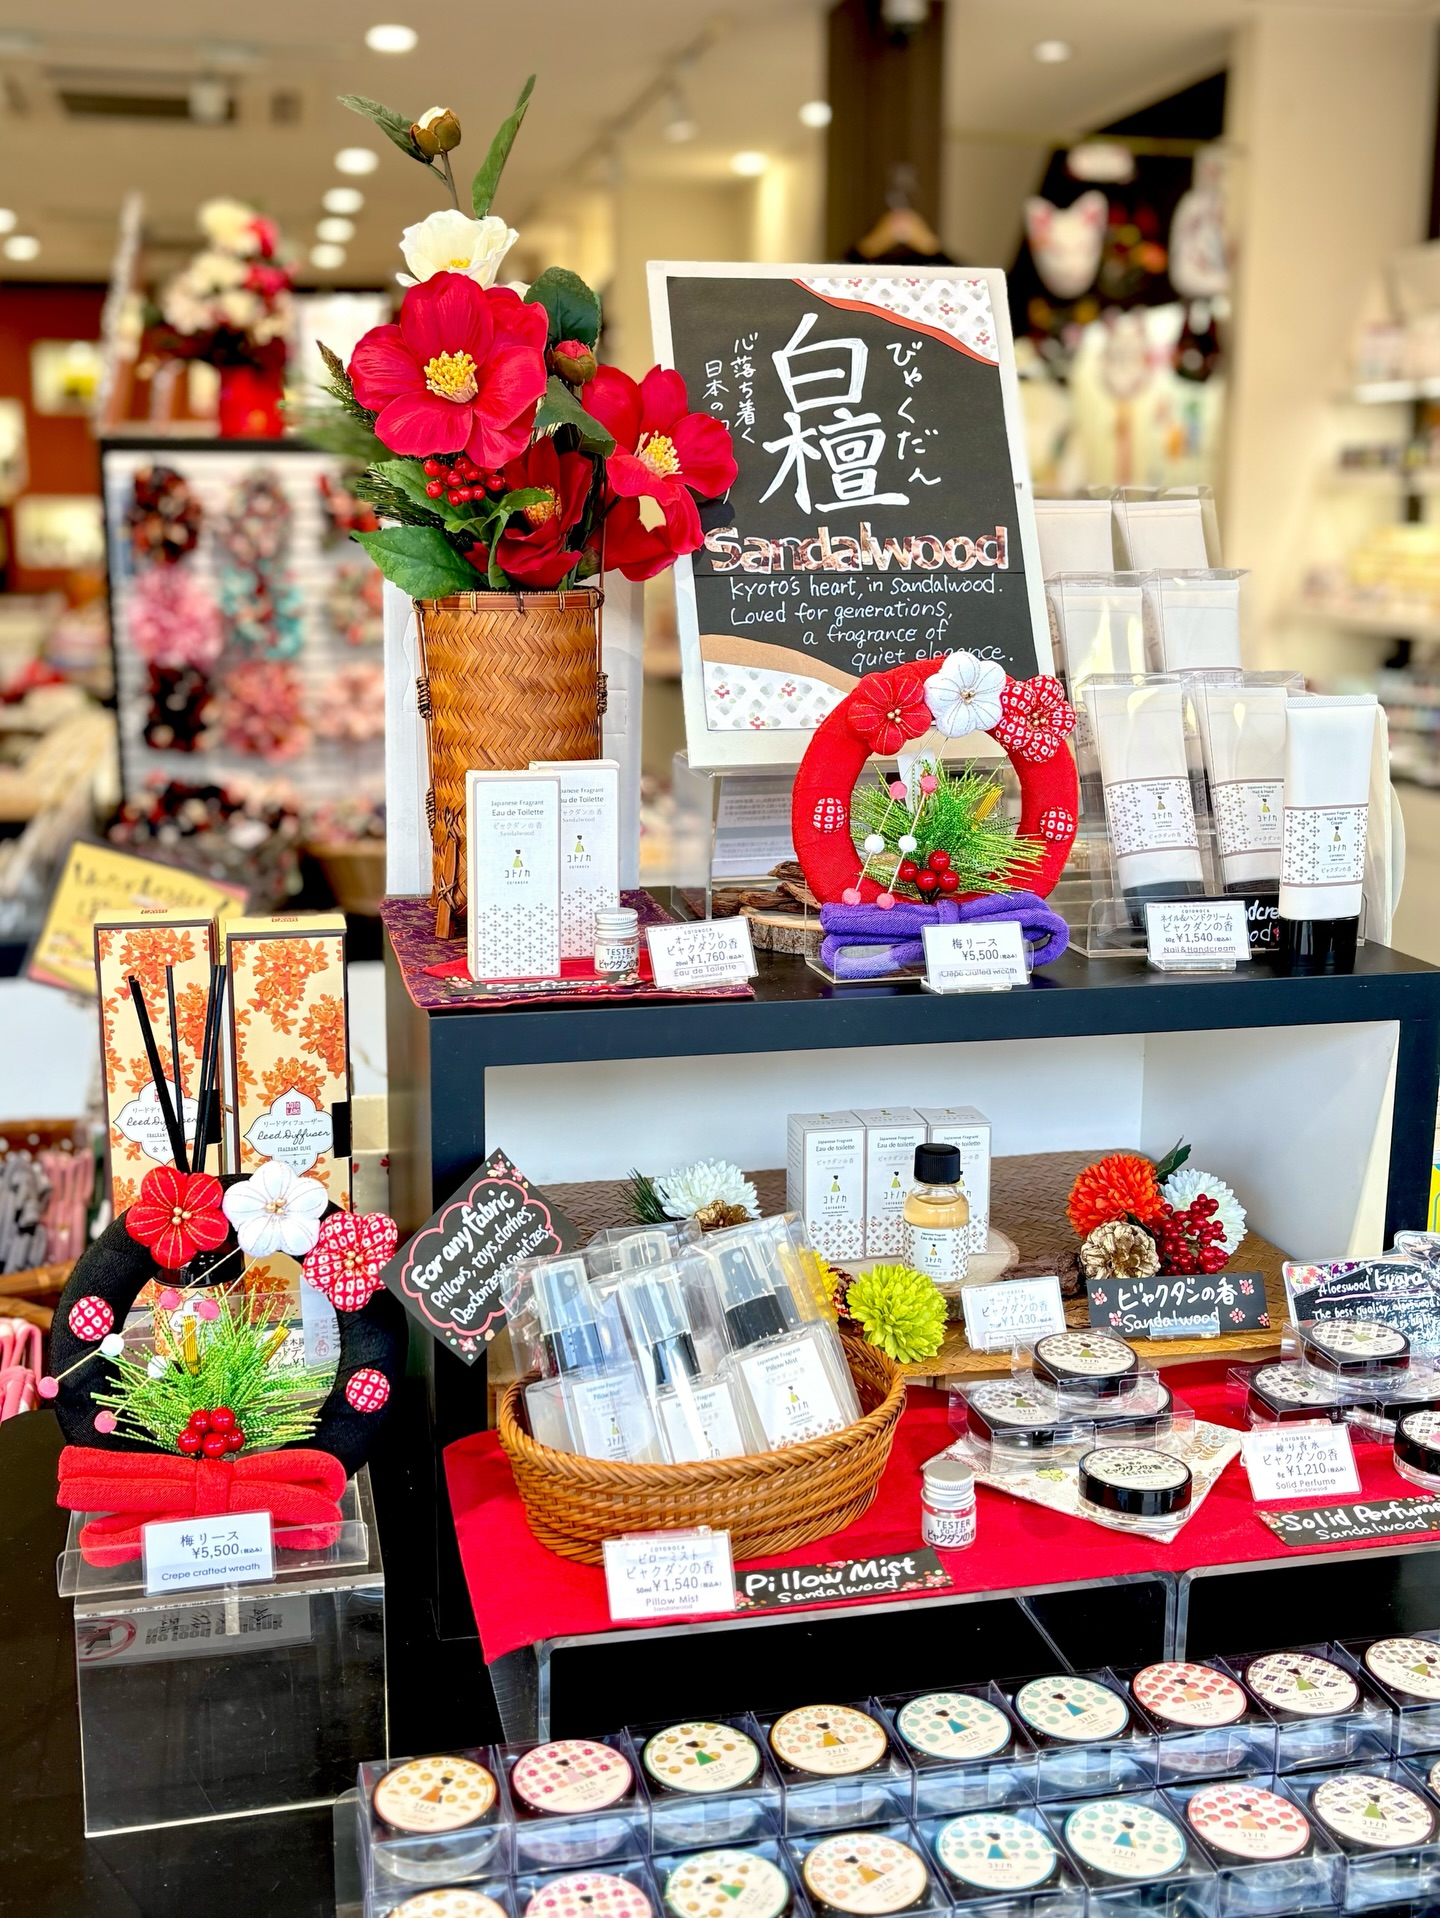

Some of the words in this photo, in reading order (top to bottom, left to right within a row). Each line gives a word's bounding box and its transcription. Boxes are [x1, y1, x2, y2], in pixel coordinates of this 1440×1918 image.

[730, 332, 758, 444] 心落ち着く
[759, 312, 910, 515] 白檀
[886, 341, 942, 486] びゃくだん
[704, 521, 1009, 573] Sandalwood
[809, 575, 863, 600] heart,
[868, 576, 884, 595] in
[730, 607, 786, 626] Loved
[794, 602, 824, 625] for
[802, 631, 819, 646] a
[826, 624, 918, 648] fragrance
[925, 617, 949, 641] of
[851, 646, 906, 673] quiet
[568, 796, 578, 804] de
[492, 809, 505, 817] Eau
[506, 808, 516, 816] de
[517, 808, 544, 816] Toilette
[1163, 922, 1233, 932] ビャクダンの香
[675, 931, 724, 944] オードトワレ
[952, 938, 998, 950] 梅リース
[1176, 932, 1213, 943] ¥1,540
[606, 947, 636, 956] TESTER
[667, 938, 738, 957] ビャクダンの香
[962, 949, 999, 962] ¥5,500
[688, 951, 726, 966] ¥1,760
[411, 1255, 445, 1290] For
[442, 1226, 475, 1262] any
[461, 1189, 515, 1235] fabric
[1118, 1276, 1238, 1311] ビャクダンの香
[981, 1300, 1048, 1317] ビャクダンの香
[1001, 1313, 1036, 1327] ¥1,430
[1122, 1306, 1220, 1333] Sandalwood
[1262, 1449, 1338, 1466] ビャクダンの香
[1286, 1462, 1326, 1477] ¥1,210
[1276, 1479, 1298, 1490] Solid
[1300, 1477, 1336, 1487] Perfume
[1281, 1508, 1353, 1532] Solid
[1353, 1499, 1440, 1523] Perfume
[936, 1519, 971, 1530] TESTER
[1316, 1516, 1428, 1540] Sandalwood
[180, 1531, 239, 1547] 梅リース
[192, 1543, 240, 1559] ¥5,500
[161, 1571, 191, 1581] Crepe
[192, 1566, 227, 1577] crafted
[228, 1563, 260, 1572] wreath
[627, 1560, 713, 1580] ビャクダンの香
[745, 1570, 842, 1597] Pillow
[850, 1557, 915, 1585] Mist
[652, 1576, 698, 1592] ¥1,540
[777, 1576, 898, 1603] Sandalwood
[645, 1596, 675, 1606] Pillow
[679, 1594, 699, 1604] Mist
